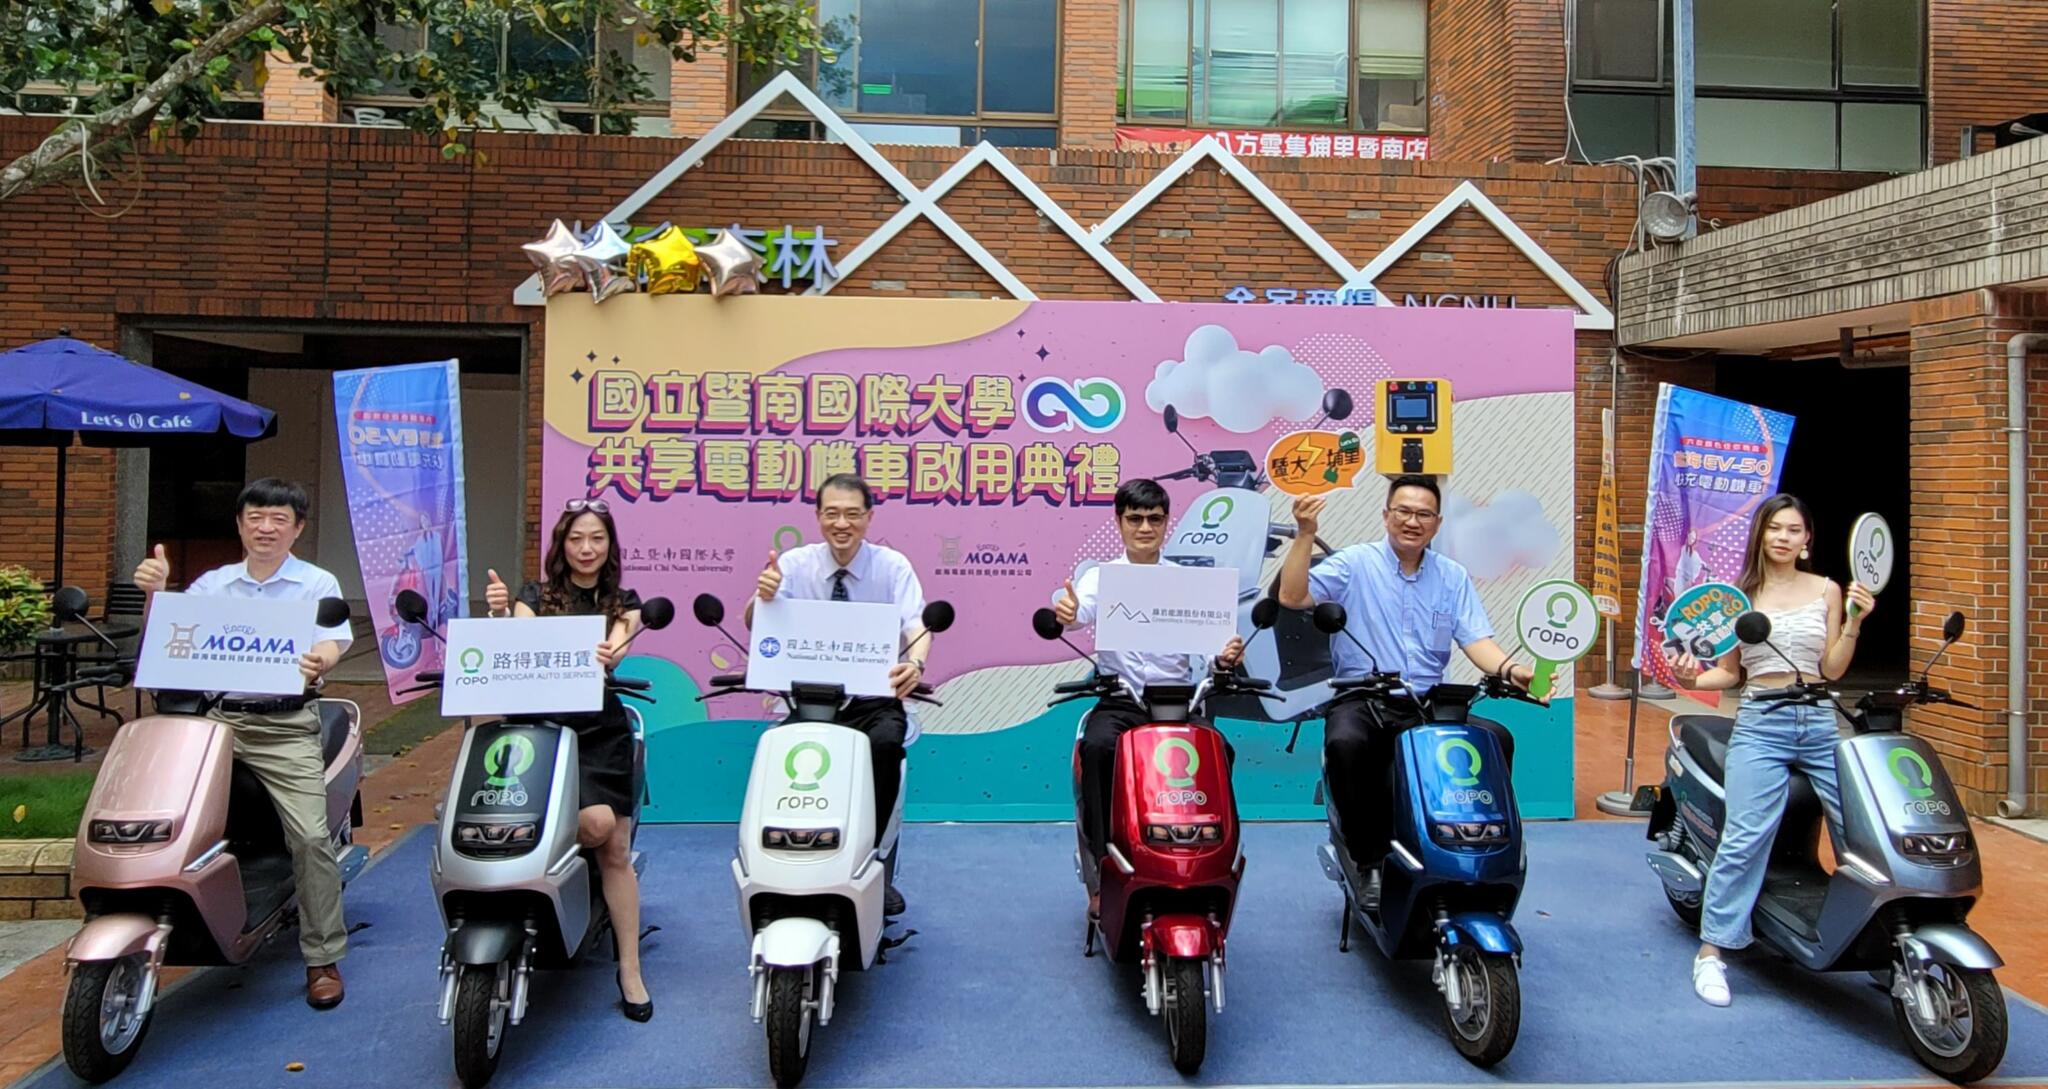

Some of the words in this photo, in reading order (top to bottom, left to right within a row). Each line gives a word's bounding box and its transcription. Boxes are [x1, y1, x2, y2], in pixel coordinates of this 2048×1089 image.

[588, 371, 1017, 436] 國立暨南國際大學
[81, 411, 124, 428] Let's
[147, 415, 193, 429] Café
[964, 552, 1029, 564] MOANA
[621, 563, 652, 572] ational
[654, 563, 670, 572] Chi
[672, 564, 689, 572] Nan
[691, 564, 734, 574] University
[201, 635, 295, 654] MOANA
[492, 651, 592, 671] 路得寶租賃
[787, 652, 818, 661] National
[819, 653, 833, 661] Chi
[851, 655, 889, 665] University
[536, 672, 561, 680] AUTO
[562, 671, 597, 680] SERVICE
